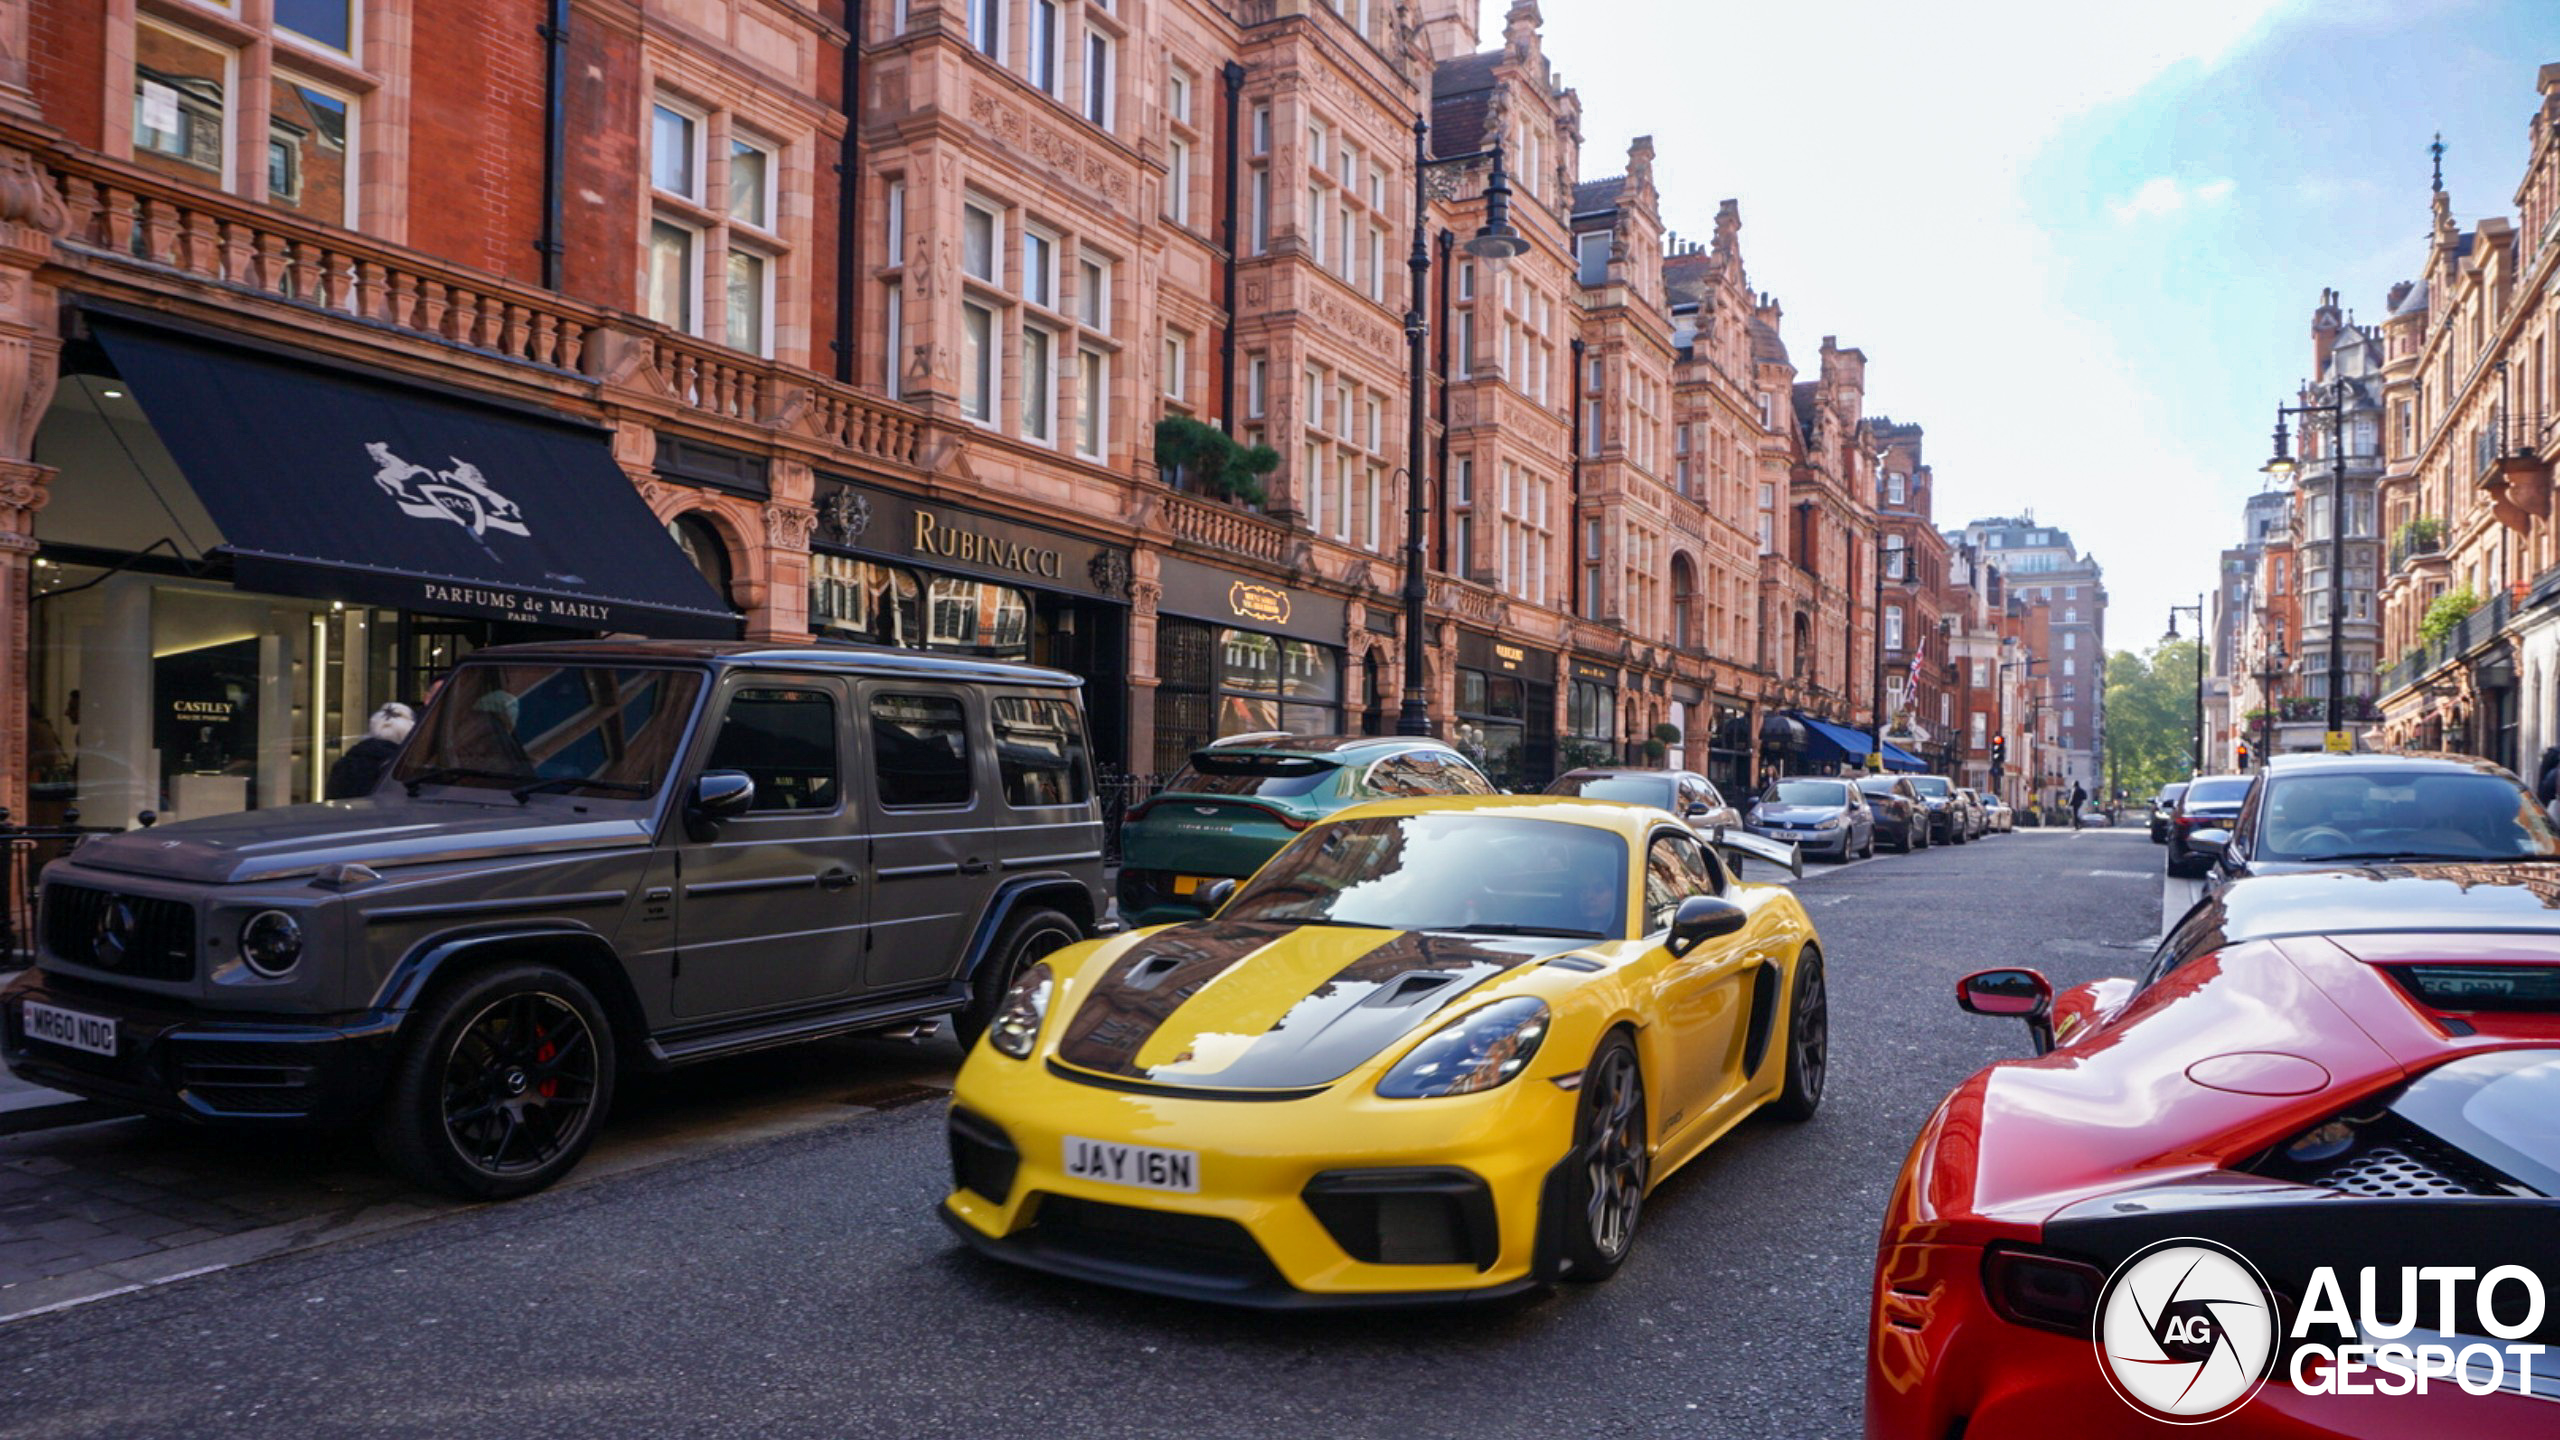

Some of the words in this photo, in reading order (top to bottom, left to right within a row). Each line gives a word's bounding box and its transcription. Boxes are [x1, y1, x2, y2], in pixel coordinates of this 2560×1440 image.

[914, 510, 1063, 578] RUBINACCI
[424, 584, 516, 609] PARFUMS
[523, 597, 543, 612] de
[551, 600, 609, 620] MARLY
[507, 612, 538, 622] PARIS
[174, 700, 232, 713] CASTLEY
[34, 1007, 75, 1042] MR60
[79, 1018, 112, 1050] NDC
[1069, 1142, 1128, 1180] JAY
